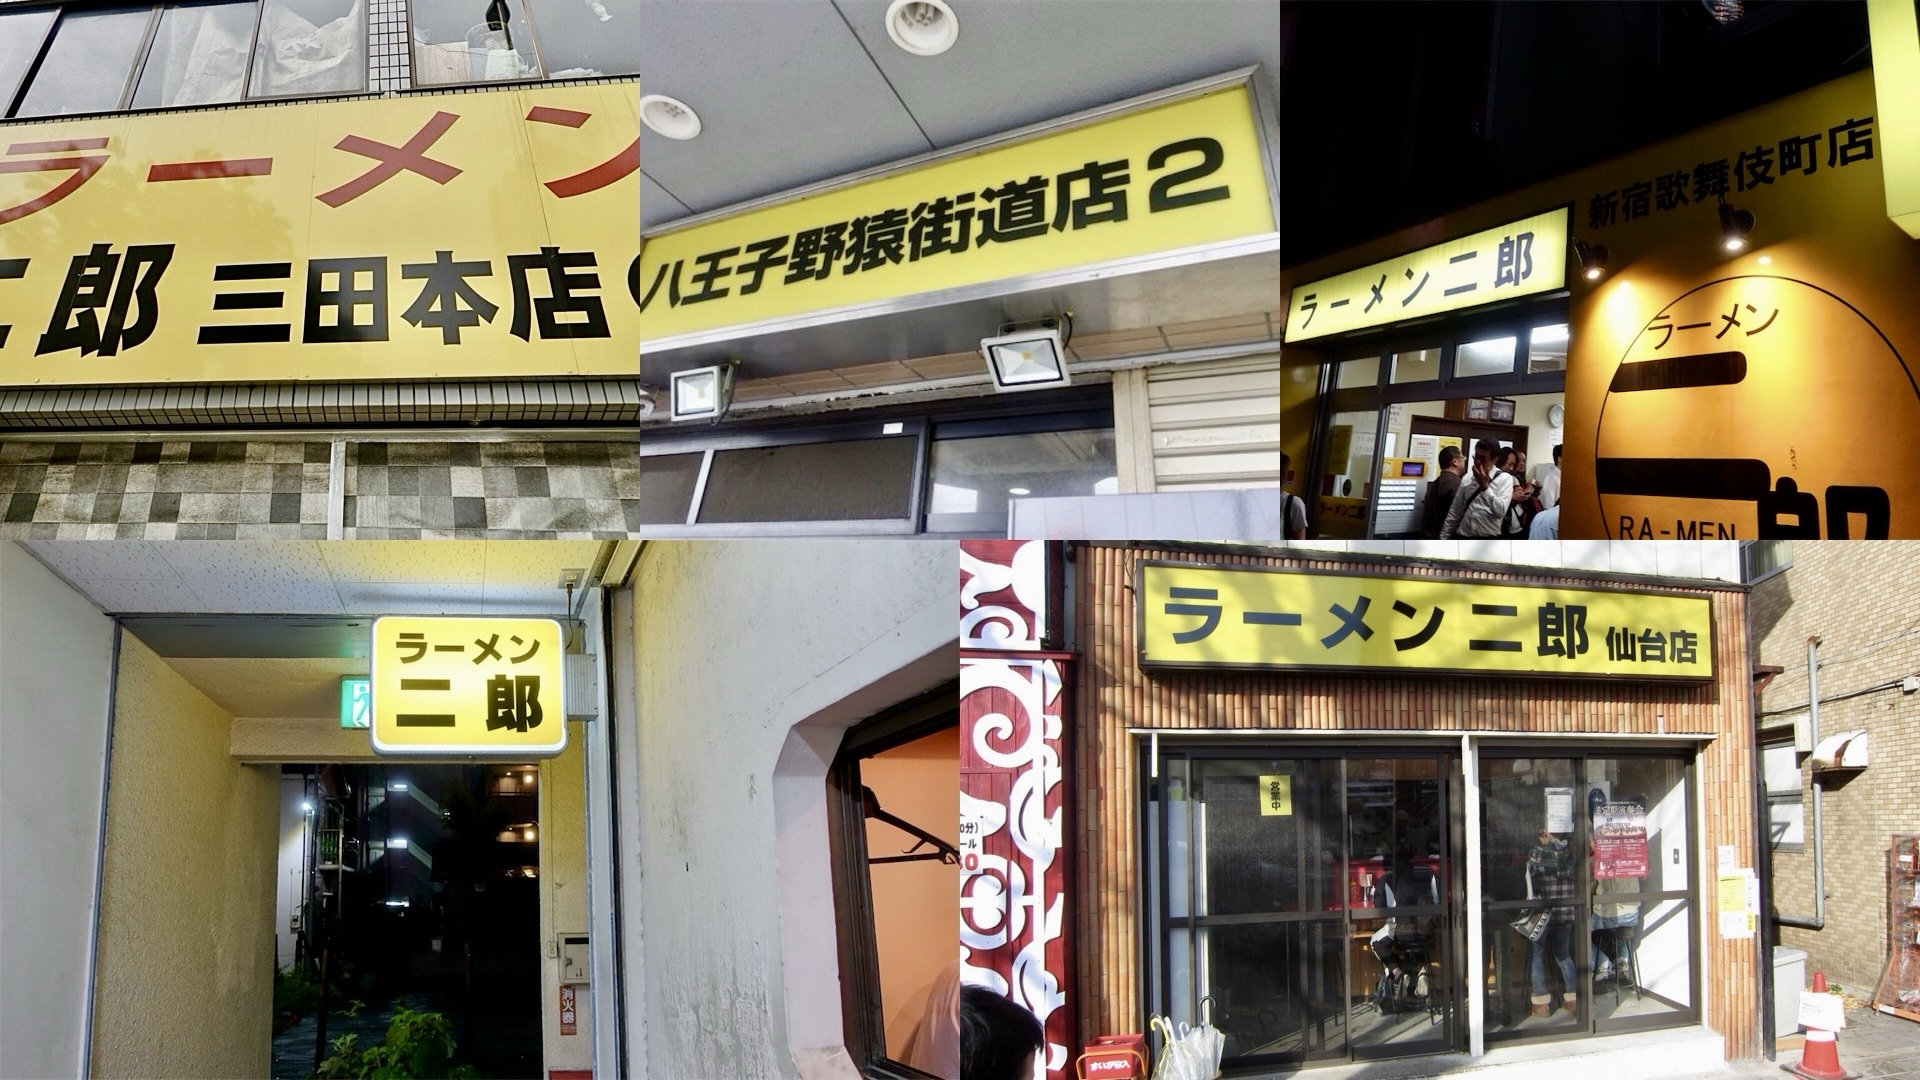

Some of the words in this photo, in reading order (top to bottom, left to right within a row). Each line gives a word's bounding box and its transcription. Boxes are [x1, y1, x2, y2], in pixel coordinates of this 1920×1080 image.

[0, 106, 640, 225] ラーメン
[1589, 116, 1874, 230] 新宿歌舞伎町店
[0, 243, 176, 357] 郎
[197, 246, 612, 346] 三田本店
[1300, 231, 1535, 330] ラーメン二郎
[1647, 302, 1779, 351] ラーメン
[395, 632, 541, 665] ラーメン
[1164, 586, 1590, 661] ラーメン二郎
[1606, 626, 1698, 664] 仙台店
[395, 673, 544, 733] 二郎
[562, 988, 574, 1024] 消火器
